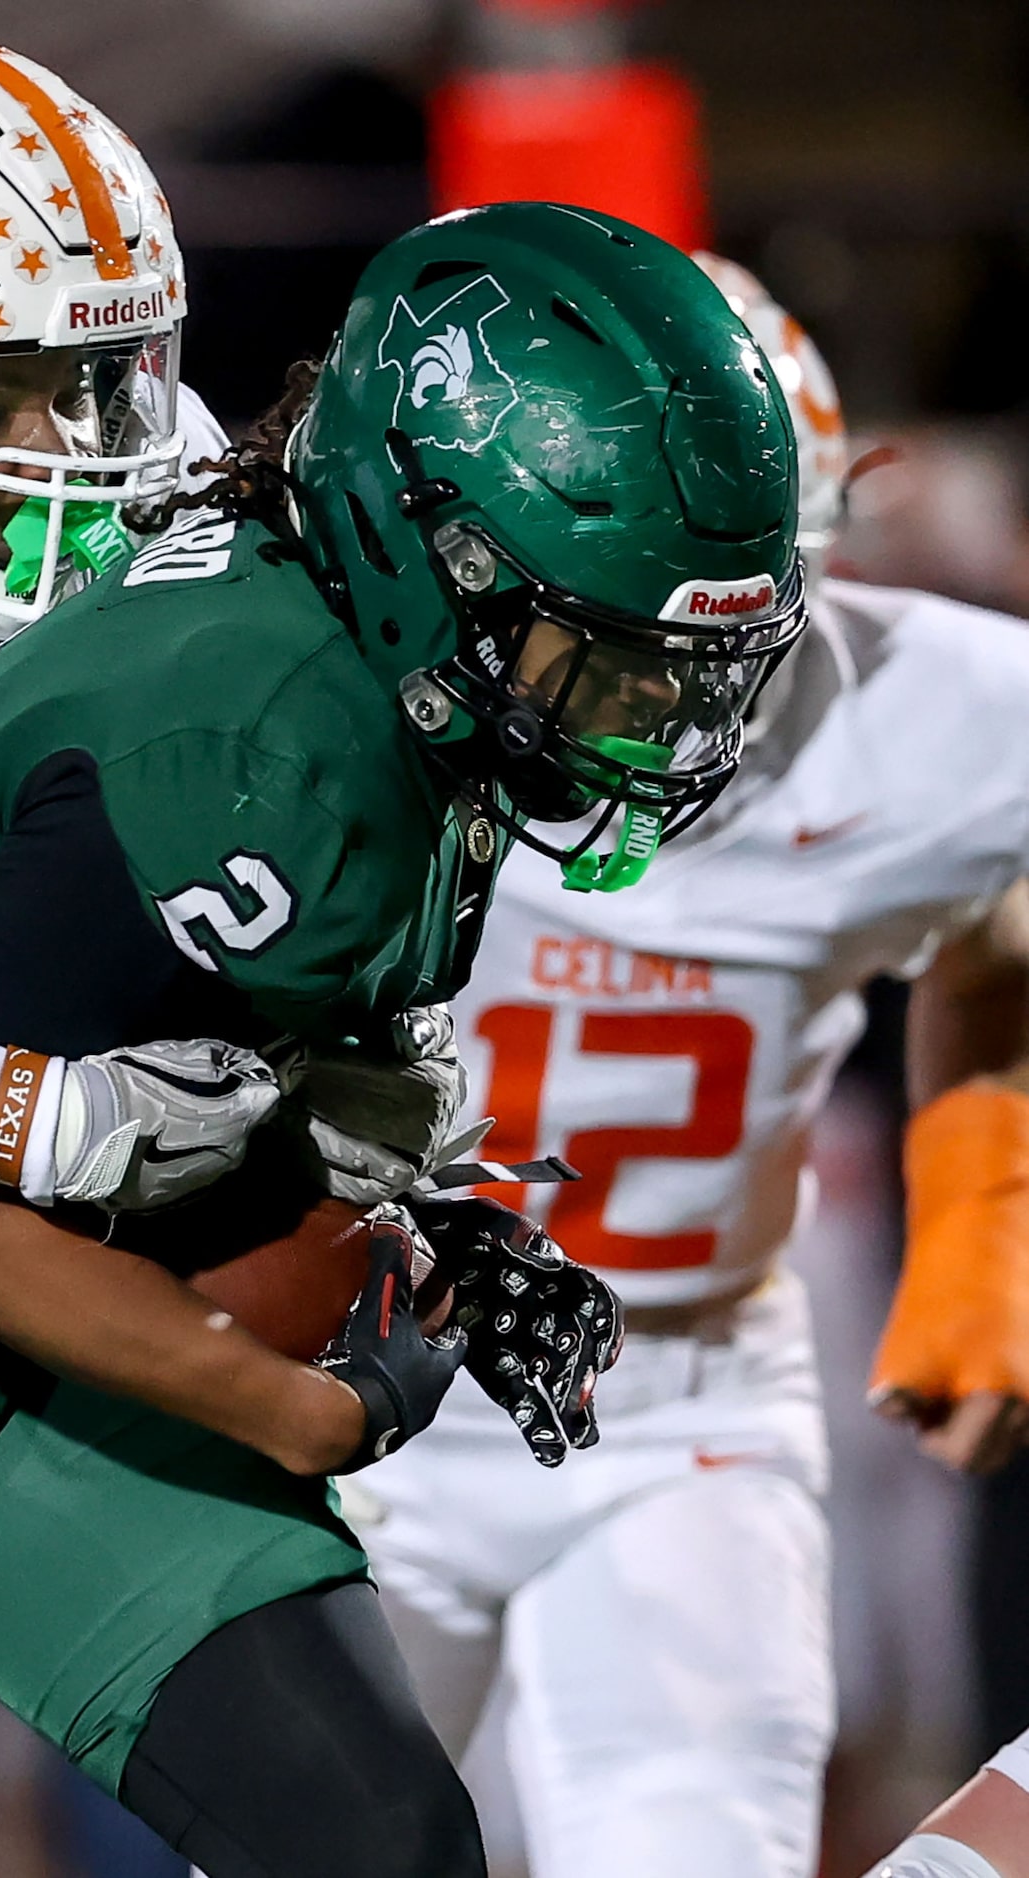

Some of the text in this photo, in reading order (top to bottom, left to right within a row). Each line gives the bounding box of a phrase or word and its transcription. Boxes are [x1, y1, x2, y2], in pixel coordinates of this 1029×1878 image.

[68, 291, 165, 329] Riddell
[688, 586, 773, 616] Riddell
[624, 811, 659, 859] RND
[150, 852, 294, 973] 2
[472, 1002, 757, 1274] 12
